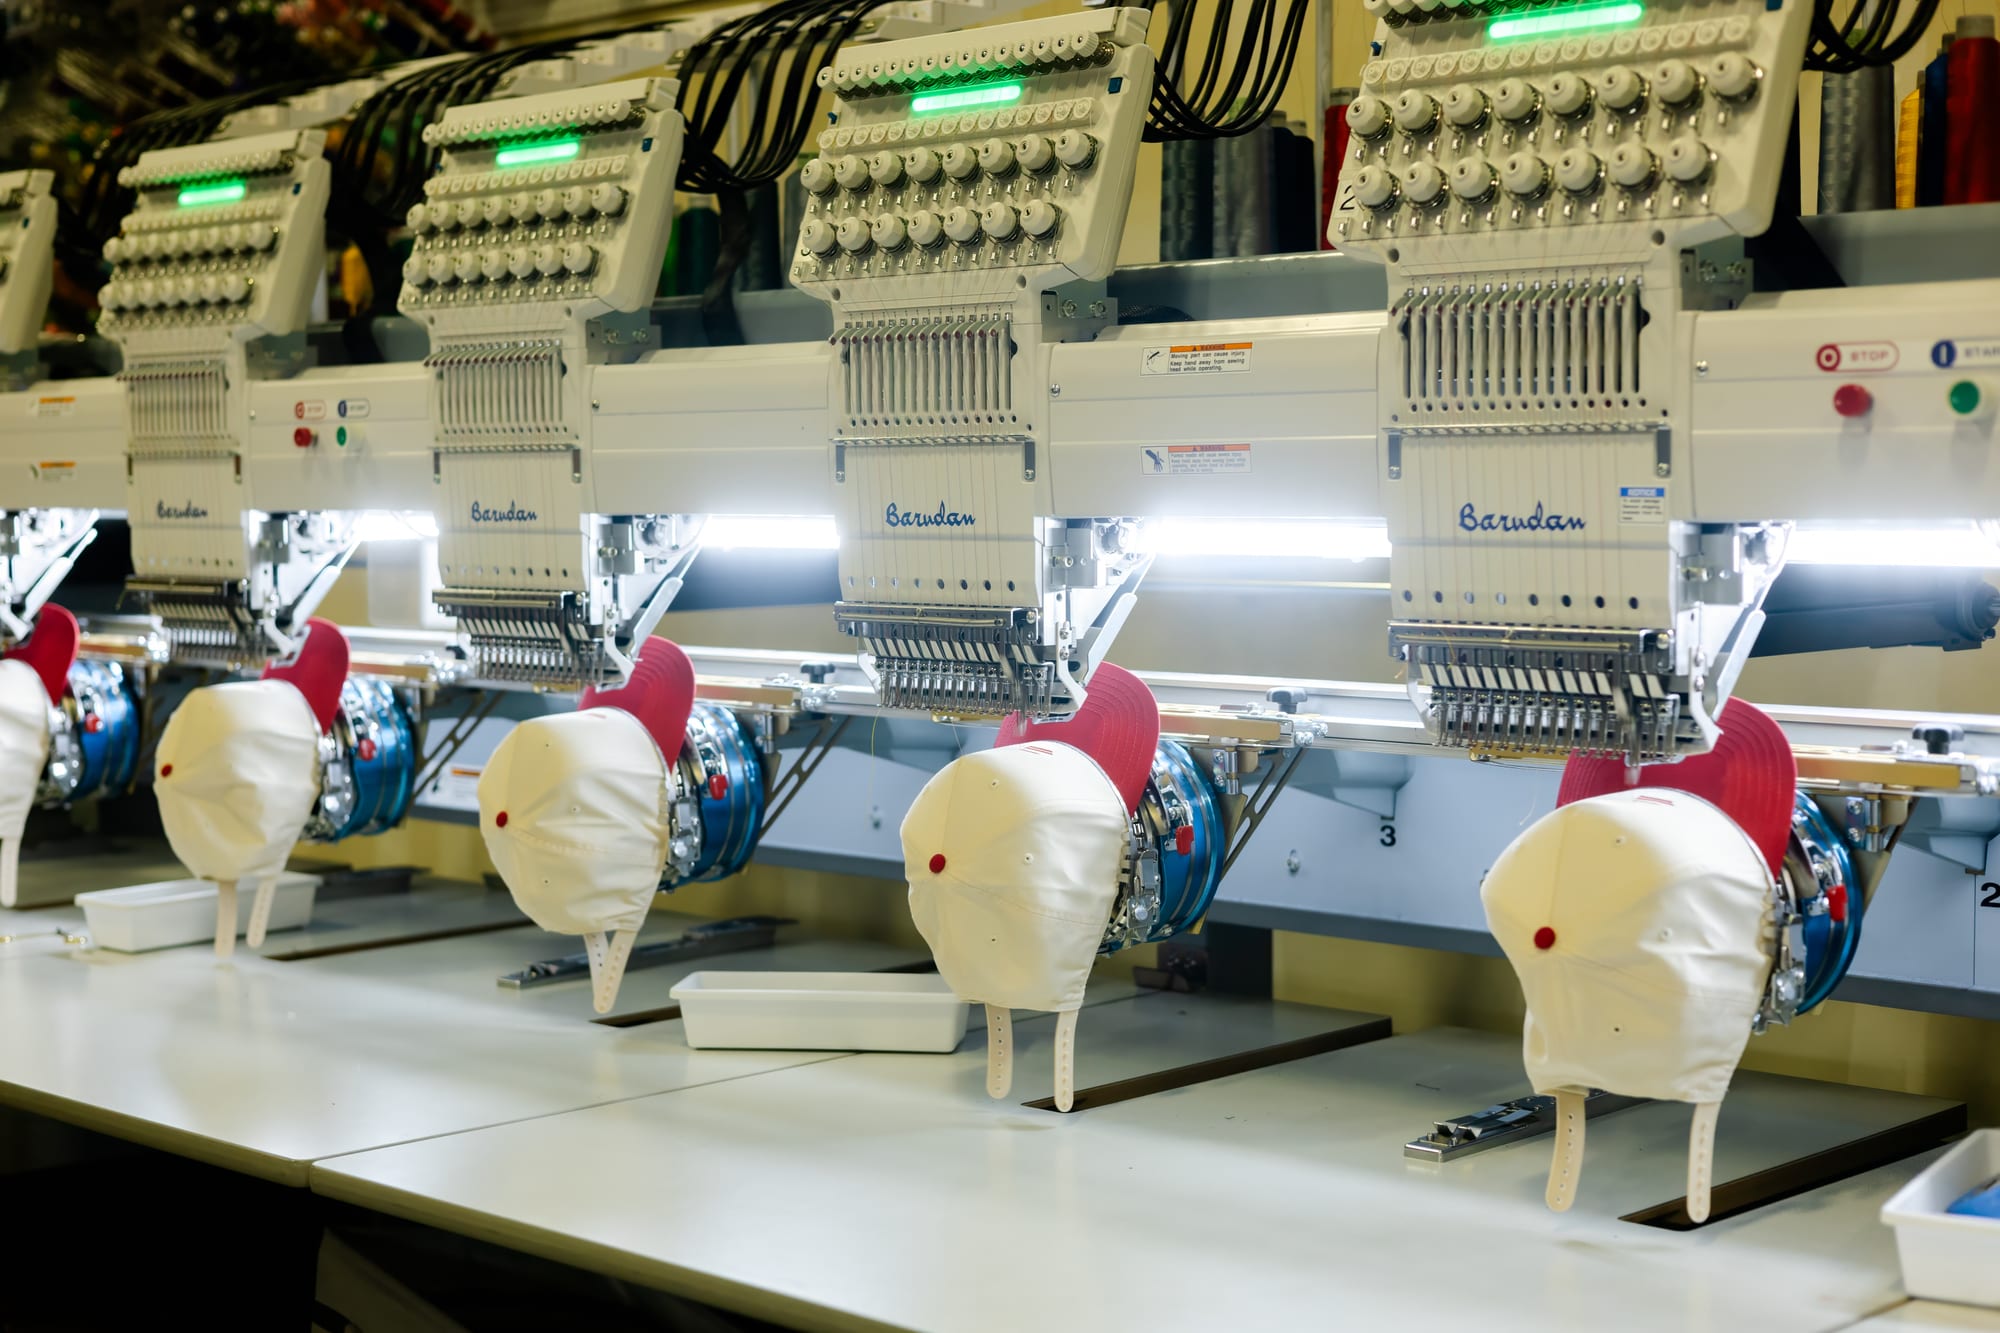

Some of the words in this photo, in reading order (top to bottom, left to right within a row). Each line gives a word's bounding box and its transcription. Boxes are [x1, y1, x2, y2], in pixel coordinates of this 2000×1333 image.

[1850, 350, 1889, 362] STOP
[471, 499, 537, 522] Barudan
[886, 499, 976, 527] Barudan
[1459, 500, 1586, 531] Barudan
[1380, 825, 1397, 847] 3
[1980, 882, 2000, 908] 2
